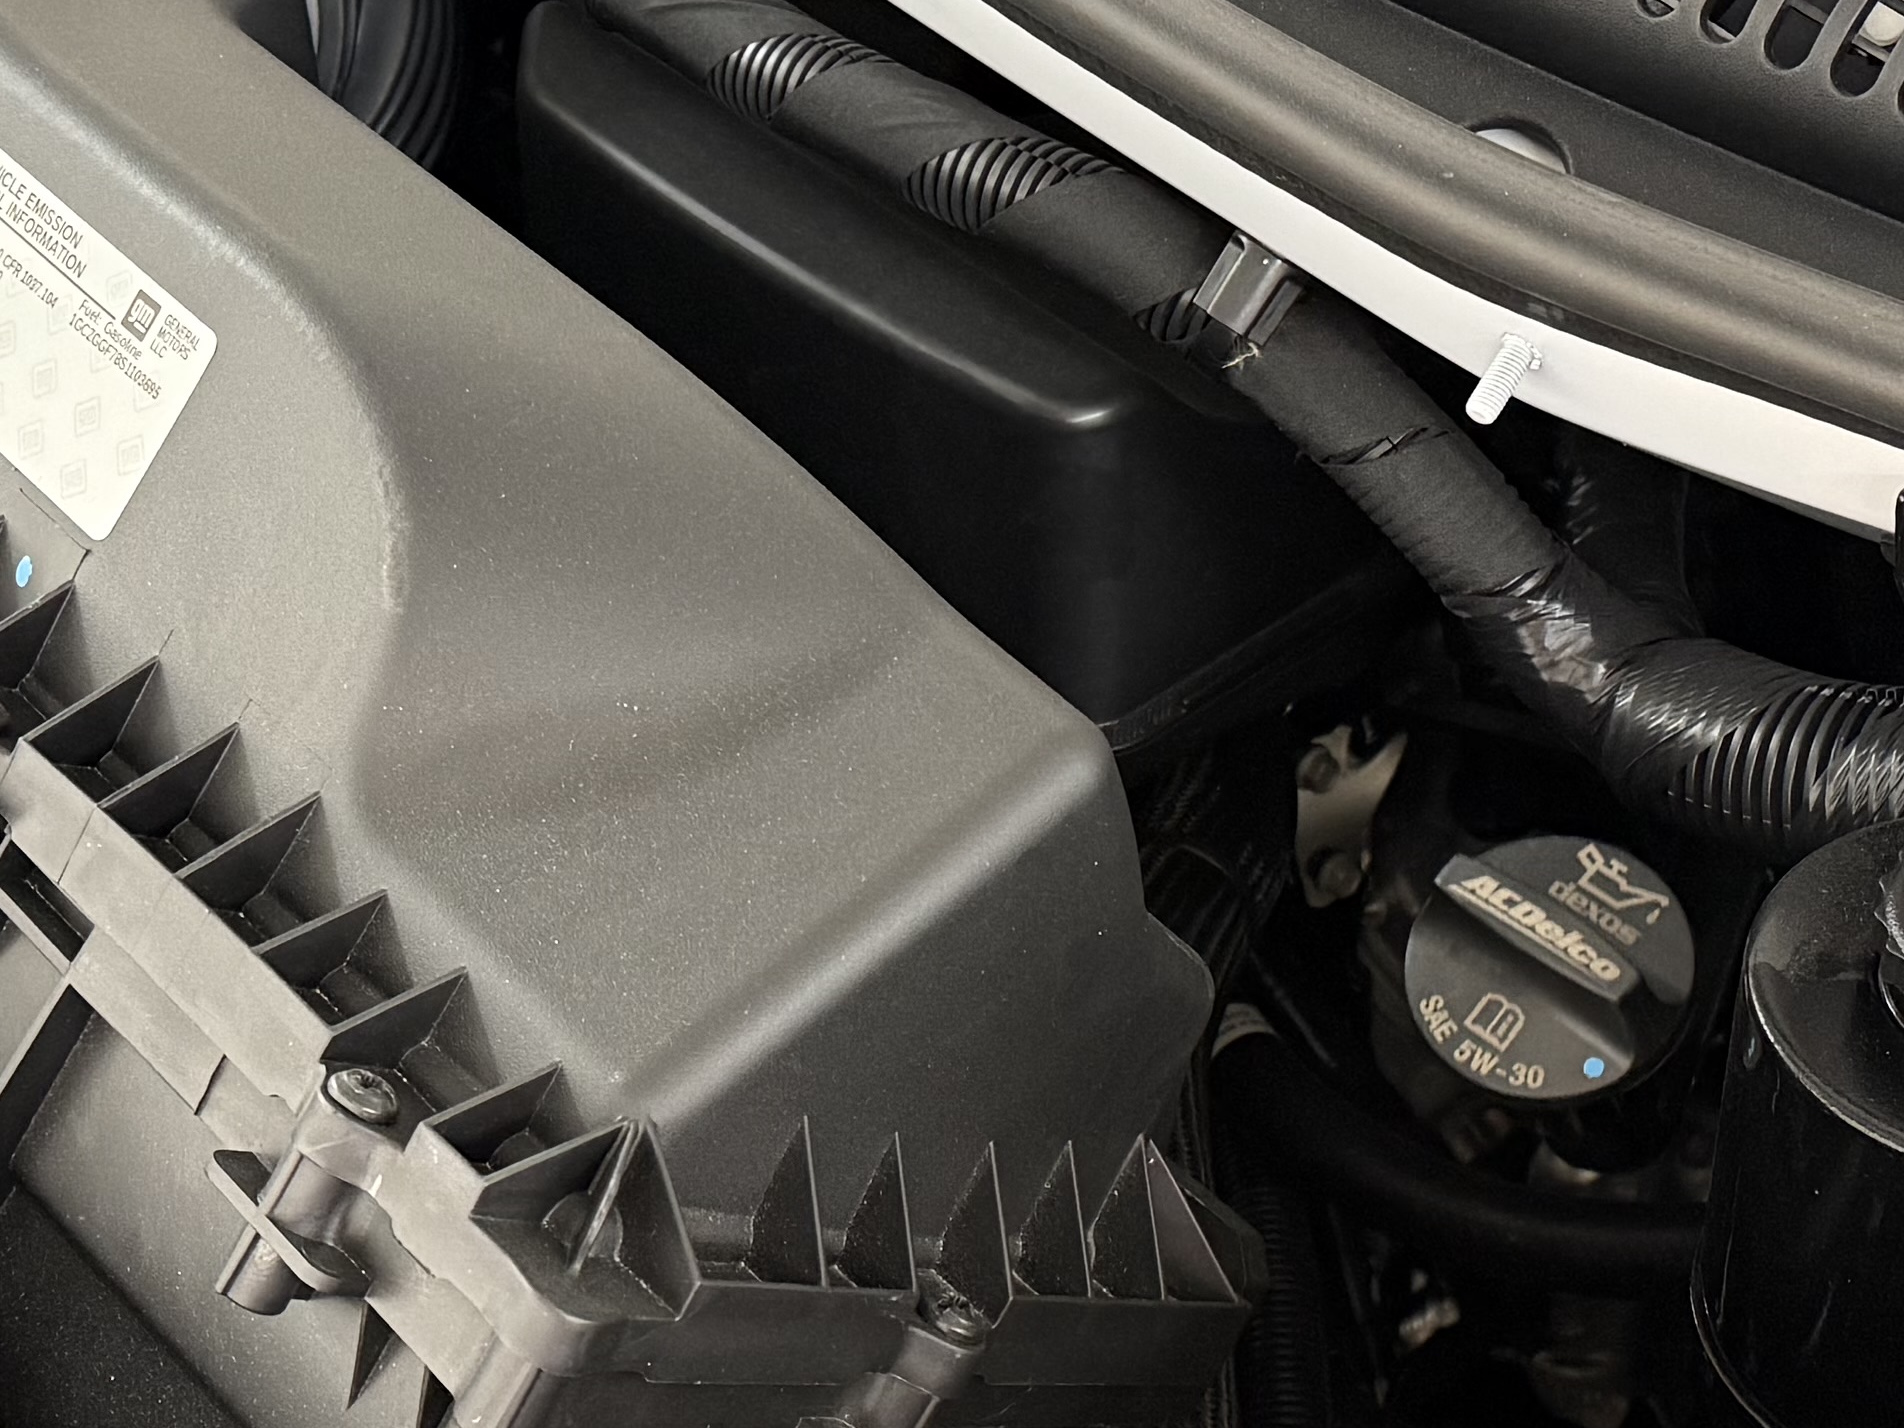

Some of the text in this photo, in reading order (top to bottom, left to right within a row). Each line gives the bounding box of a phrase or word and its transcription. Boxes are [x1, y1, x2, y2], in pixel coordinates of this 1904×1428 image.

[4, 200, 87, 279] INFORMATION
[23, 190, 84, 250] EMISSION
[0, 252, 24, 279] CFR
[77, 297, 144, 362] Fuel: Gasoline
[148, 337, 168, 360] LLC
[155, 325, 191, 362] MOTORS
[162, 312, 202, 352] GENERAL
[1458, 874, 1622, 982] ACDelco
[1547, 880, 1642, 946] dexos
[1419, 994, 1546, 1089] SAE 5W-30
